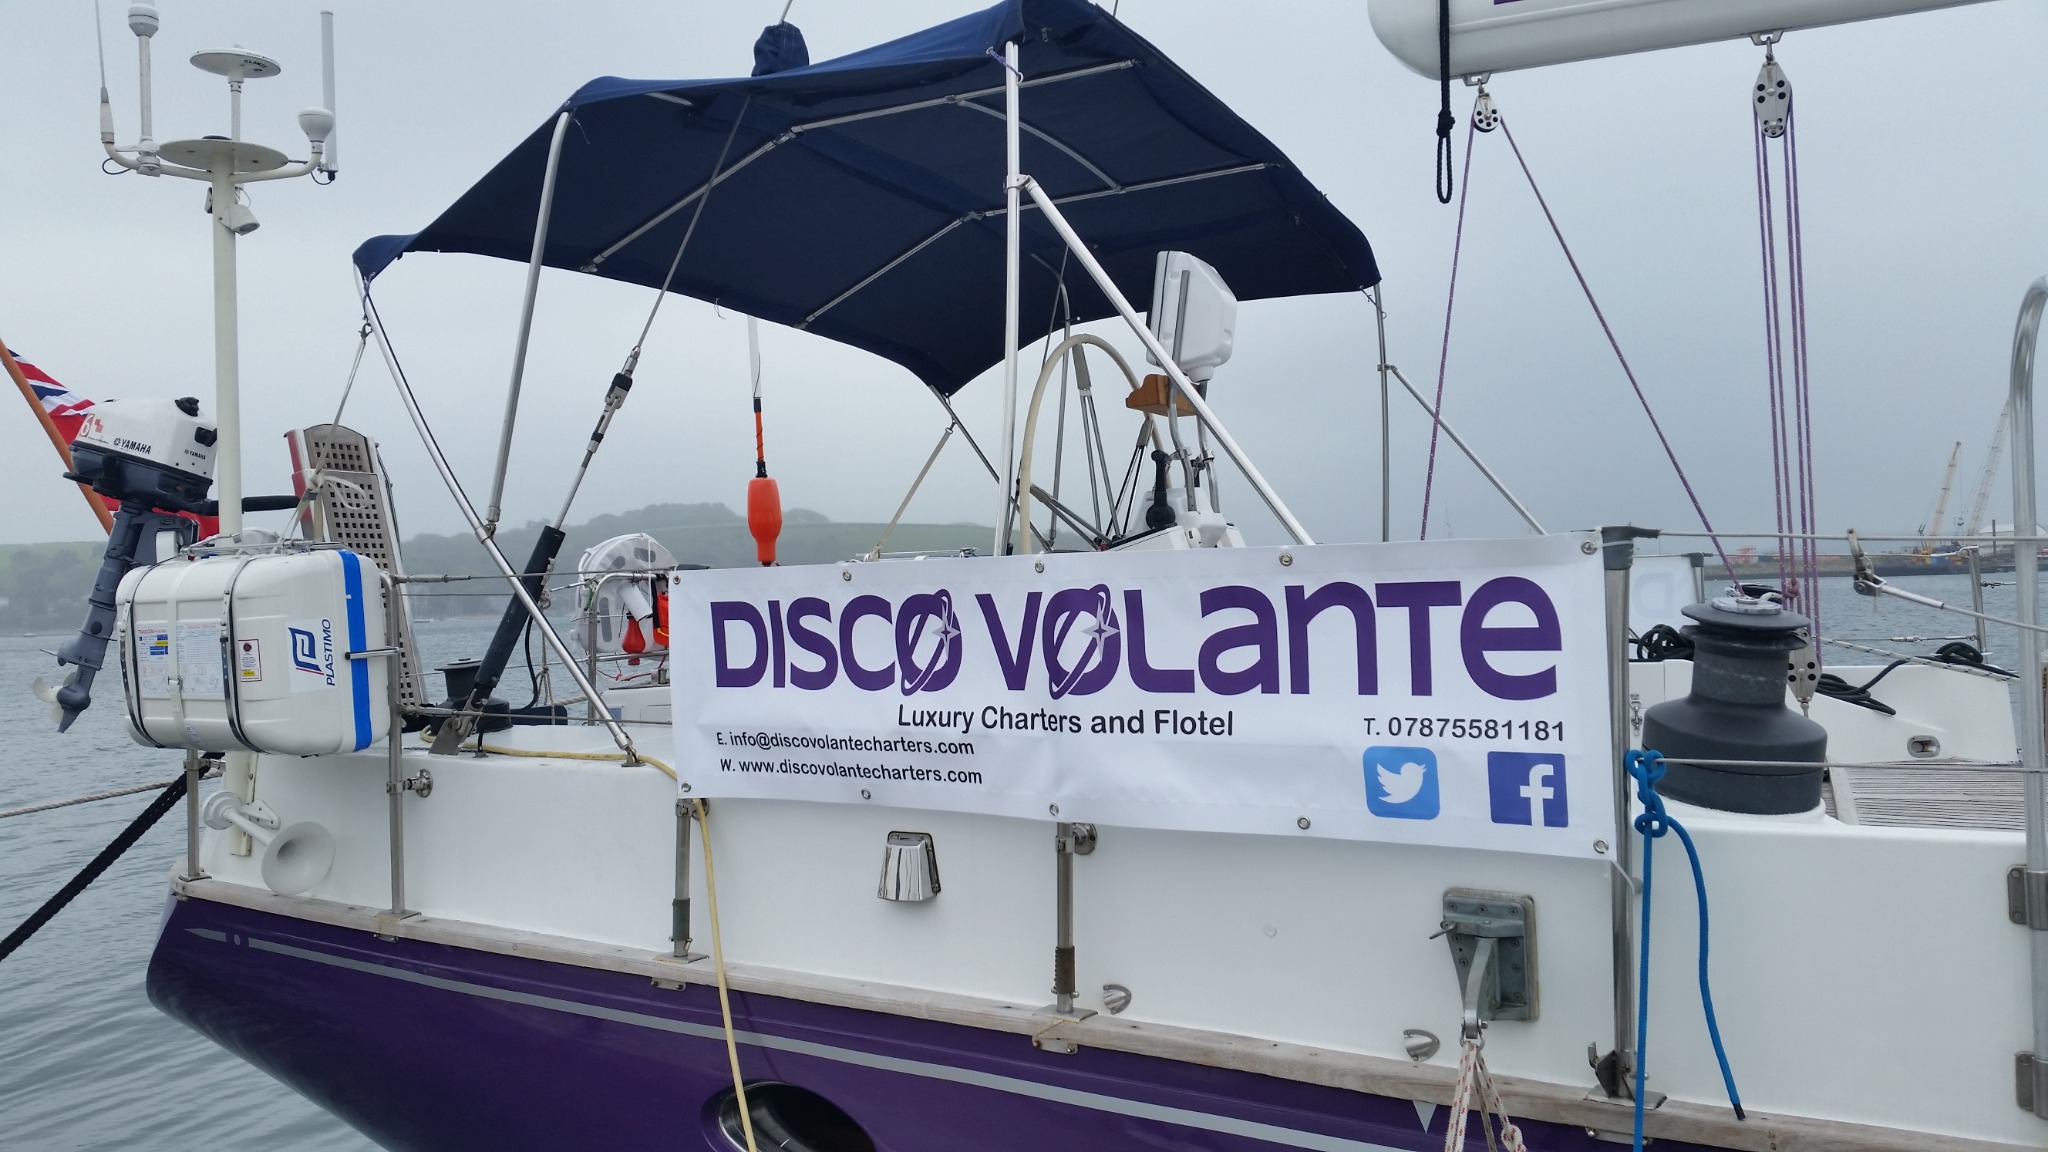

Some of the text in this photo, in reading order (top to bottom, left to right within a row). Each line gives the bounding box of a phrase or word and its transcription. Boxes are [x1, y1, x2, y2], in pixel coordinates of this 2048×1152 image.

[121, 438, 152, 455] YAMAHA
[189, 450, 206, 460] YAMAHA
[321, 618, 336, 687] PLASTIMO
[710, 588, 963, 696] DISCO
[898, 703, 1234, 736] Luxury Charters and Flotel
[1363, 716, 1564, 742] T. 07875581181
[716, 731, 975, 755] E. info@discovolantecharters.com
[720, 758, 983, 784] W. www.discovolantecharters.com
